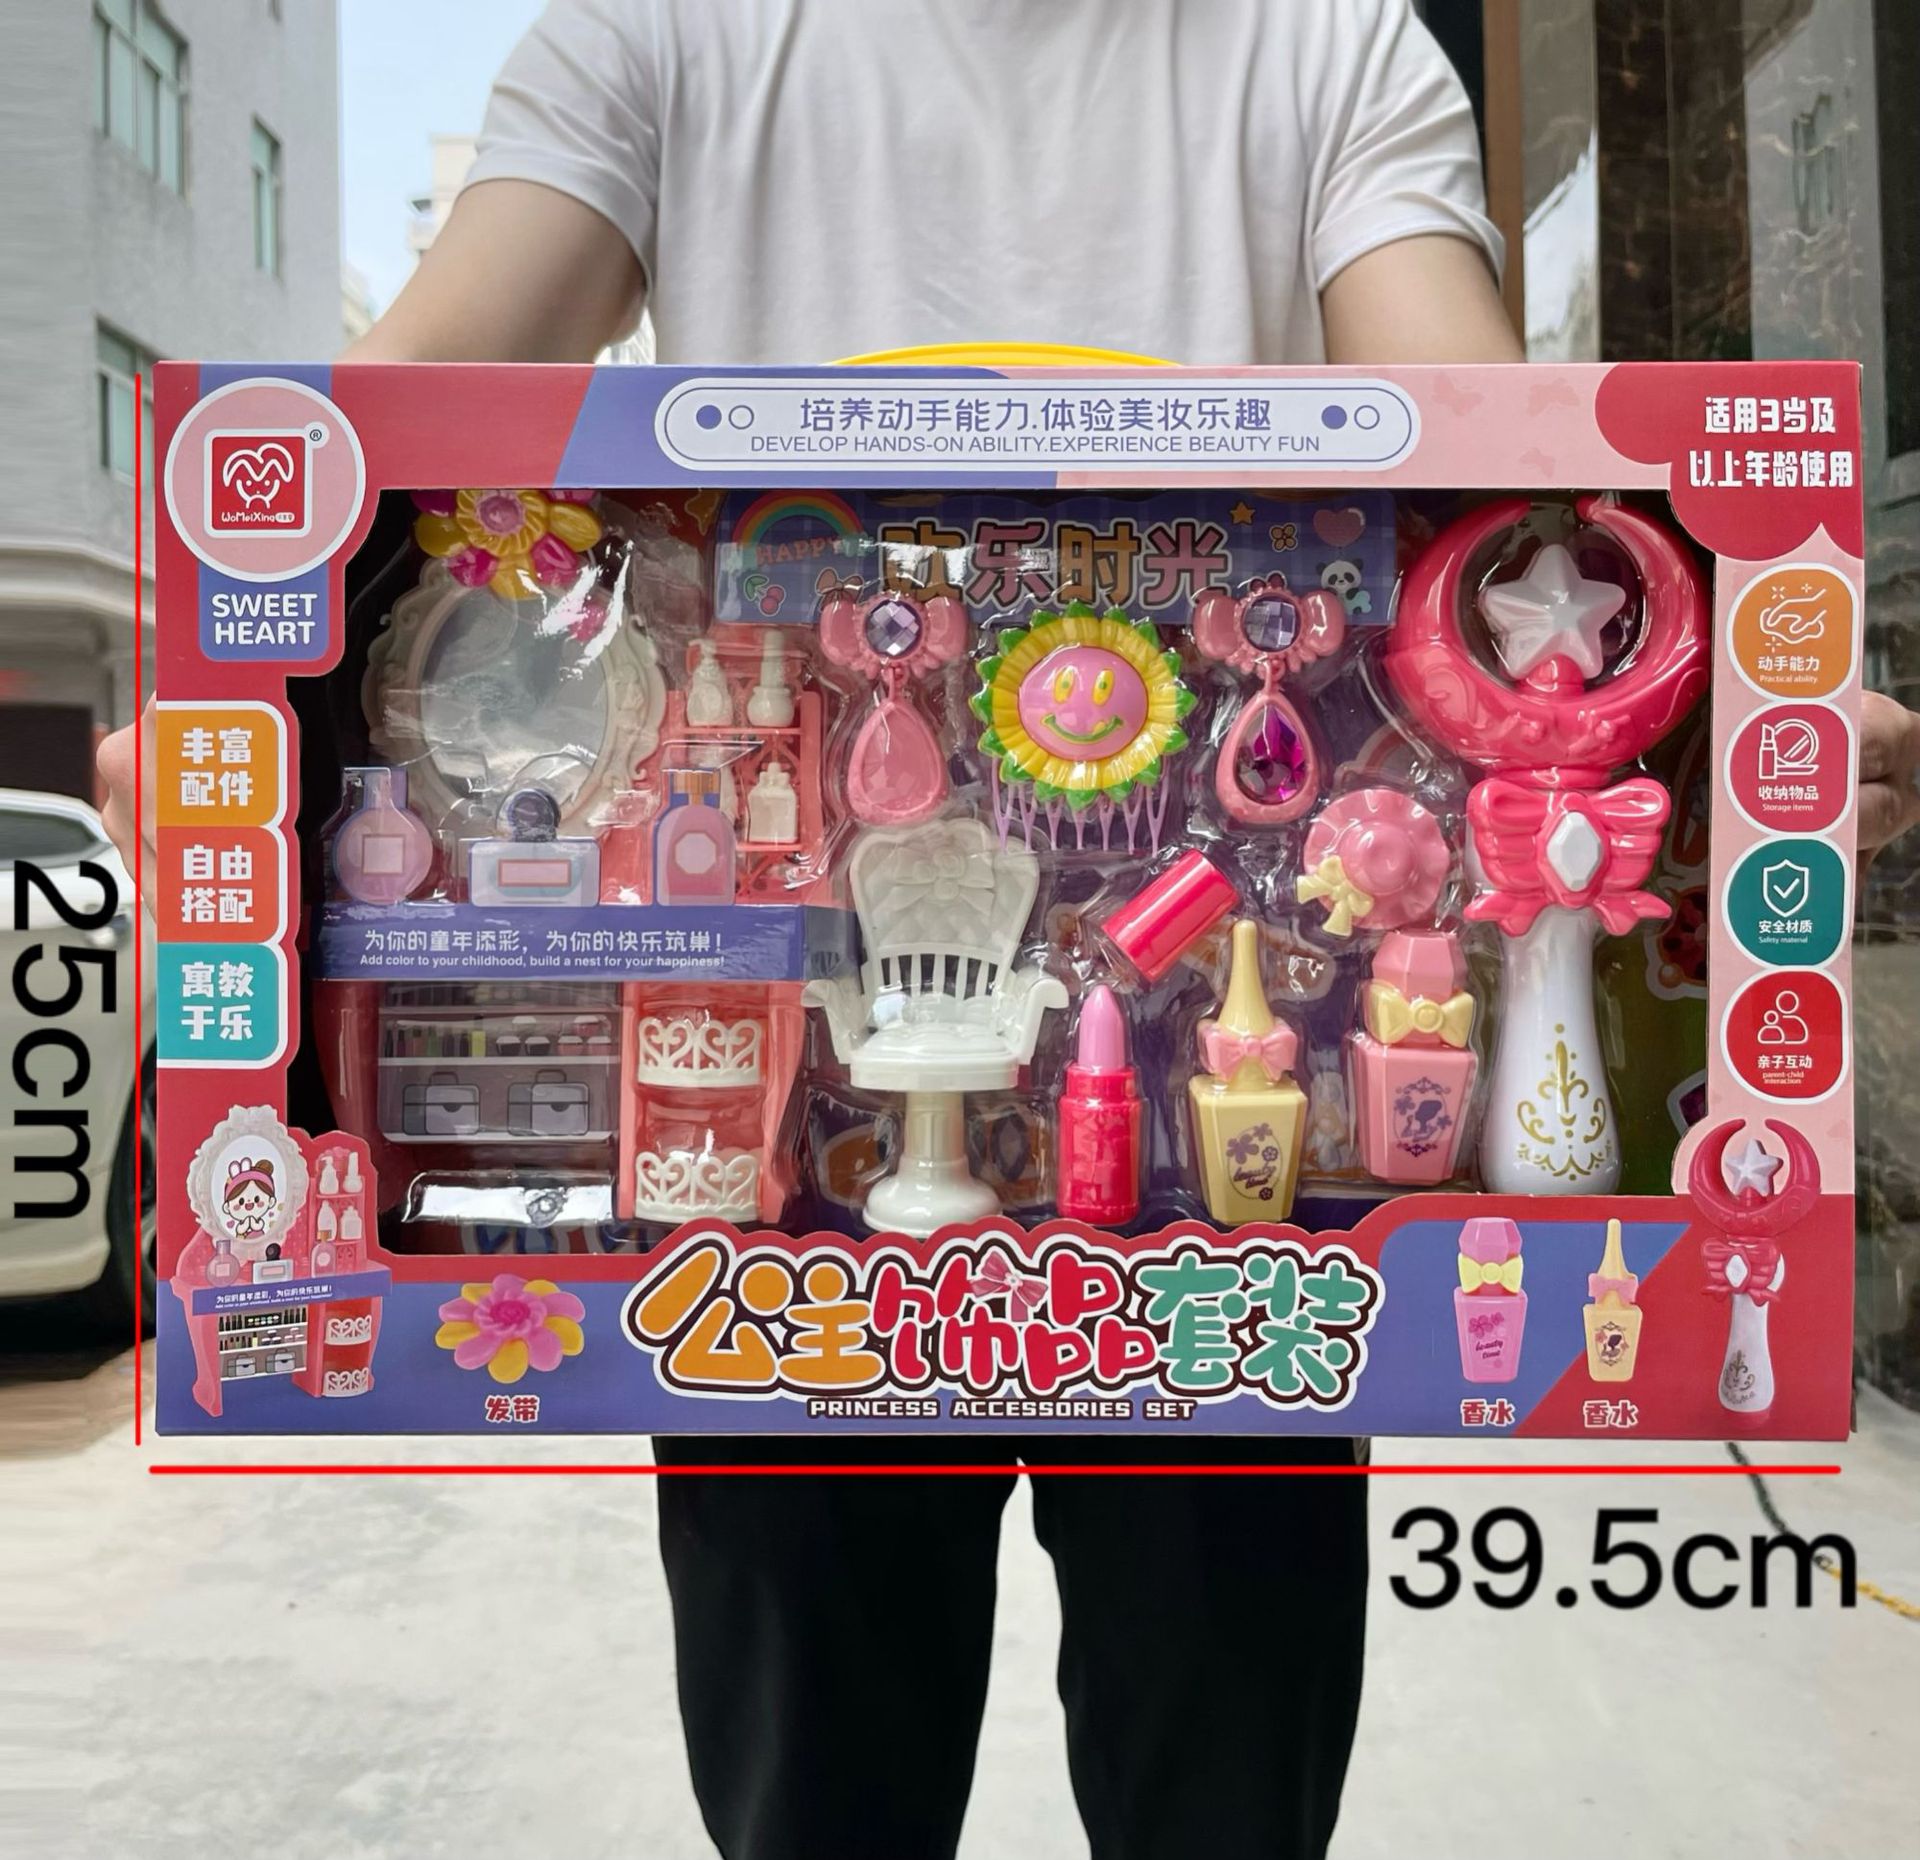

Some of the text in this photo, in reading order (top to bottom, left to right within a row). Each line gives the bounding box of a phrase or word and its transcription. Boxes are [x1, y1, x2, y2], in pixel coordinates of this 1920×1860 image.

[800, 397, 1272, 432] 培养动手能力.体验美妆乐趣
[1704, 396, 1837, 434] 适用3岁及
[751, 436, 849, 452] DEVELOP
[854, 436, 963, 452] HANDS-ON
[1189, 436, 1272, 452] BEAUTY
[1278, 436, 1320, 452] FUN
[1689, 450, 1853, 488] 以上年龄使用
[212, 593, 318, 618] SWEET
[215, 621, 316, 645] HEART
[1757, 655, 1821, 672] 动手能力
[181, 727, 254, 765] 丰富
[180, 770, 254, 807] 配件
[1758, 784, 1819, 801] 收纳物品
[1762, 802, 1792, 812] Storage
[182, 844, 254, 881] 自由
[181, 886, 254, 924] 搭配
[1758, 919, 1813, 934] 安全材质
[360, 954, 725, 969] Add color to your childhood, build a nest for your happiness!
[181, 961, 254, 998] 寓教
[181, 1004, 254, 1041] 于乐
[1757, 1054, 1813, 1069] 亲子互动
[636, 1248, 1370, 1396] 公主饰品套装
[485, 1395, 541, 1423] 发带
[809, 1399, 1196, 1418] PRINCESS ACCESSORIES SET
[1460, 1398, 1516, 1426] 香水
[1583, 1399, 1639, 1428] 香水
